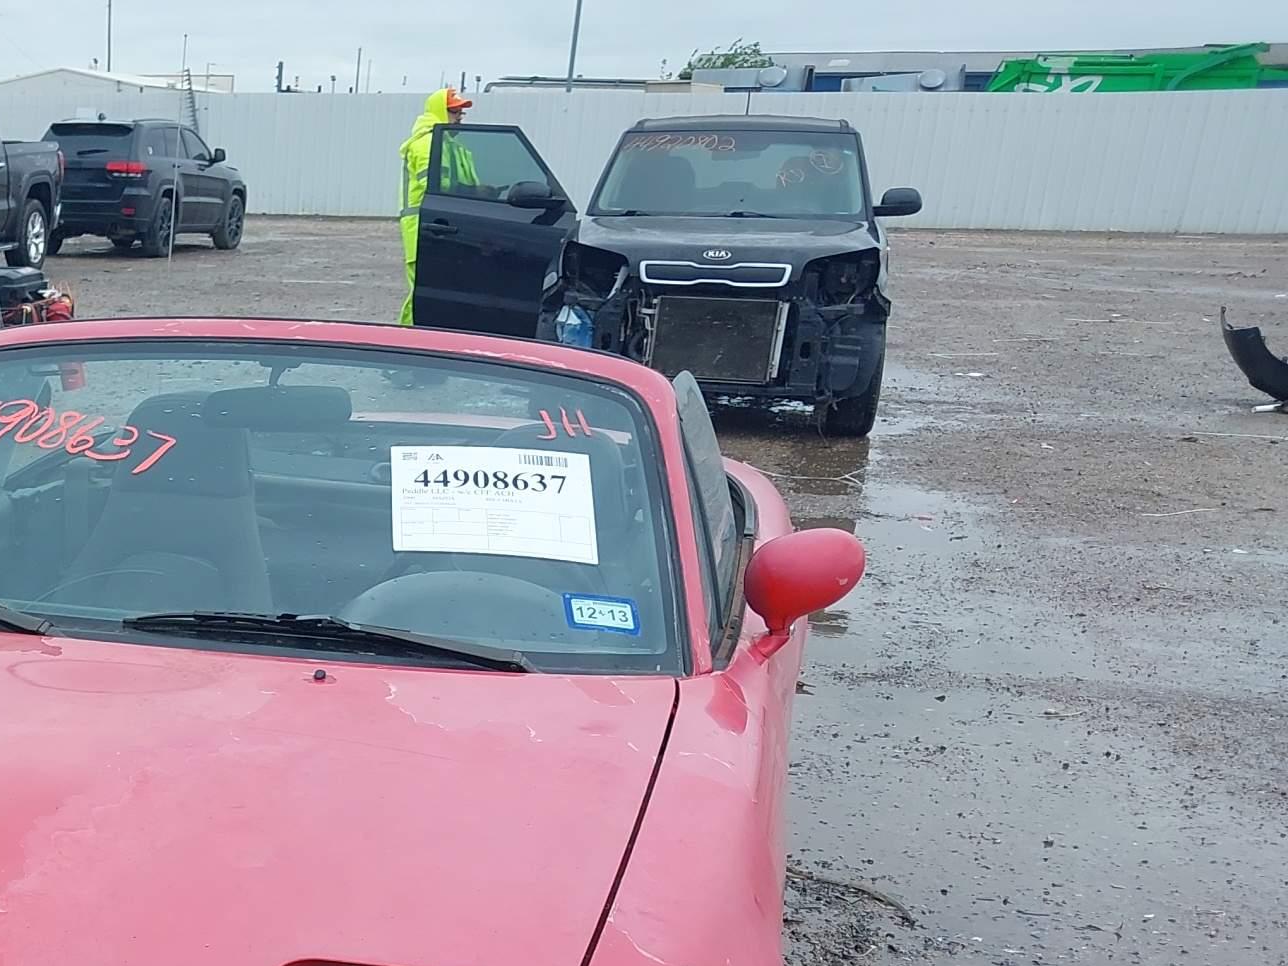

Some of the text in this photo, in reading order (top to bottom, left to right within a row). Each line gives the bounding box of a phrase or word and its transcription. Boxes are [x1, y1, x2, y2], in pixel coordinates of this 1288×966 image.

[414, 468, 567, 494] 44908637
[575, 606, 629, 623] 12 13
